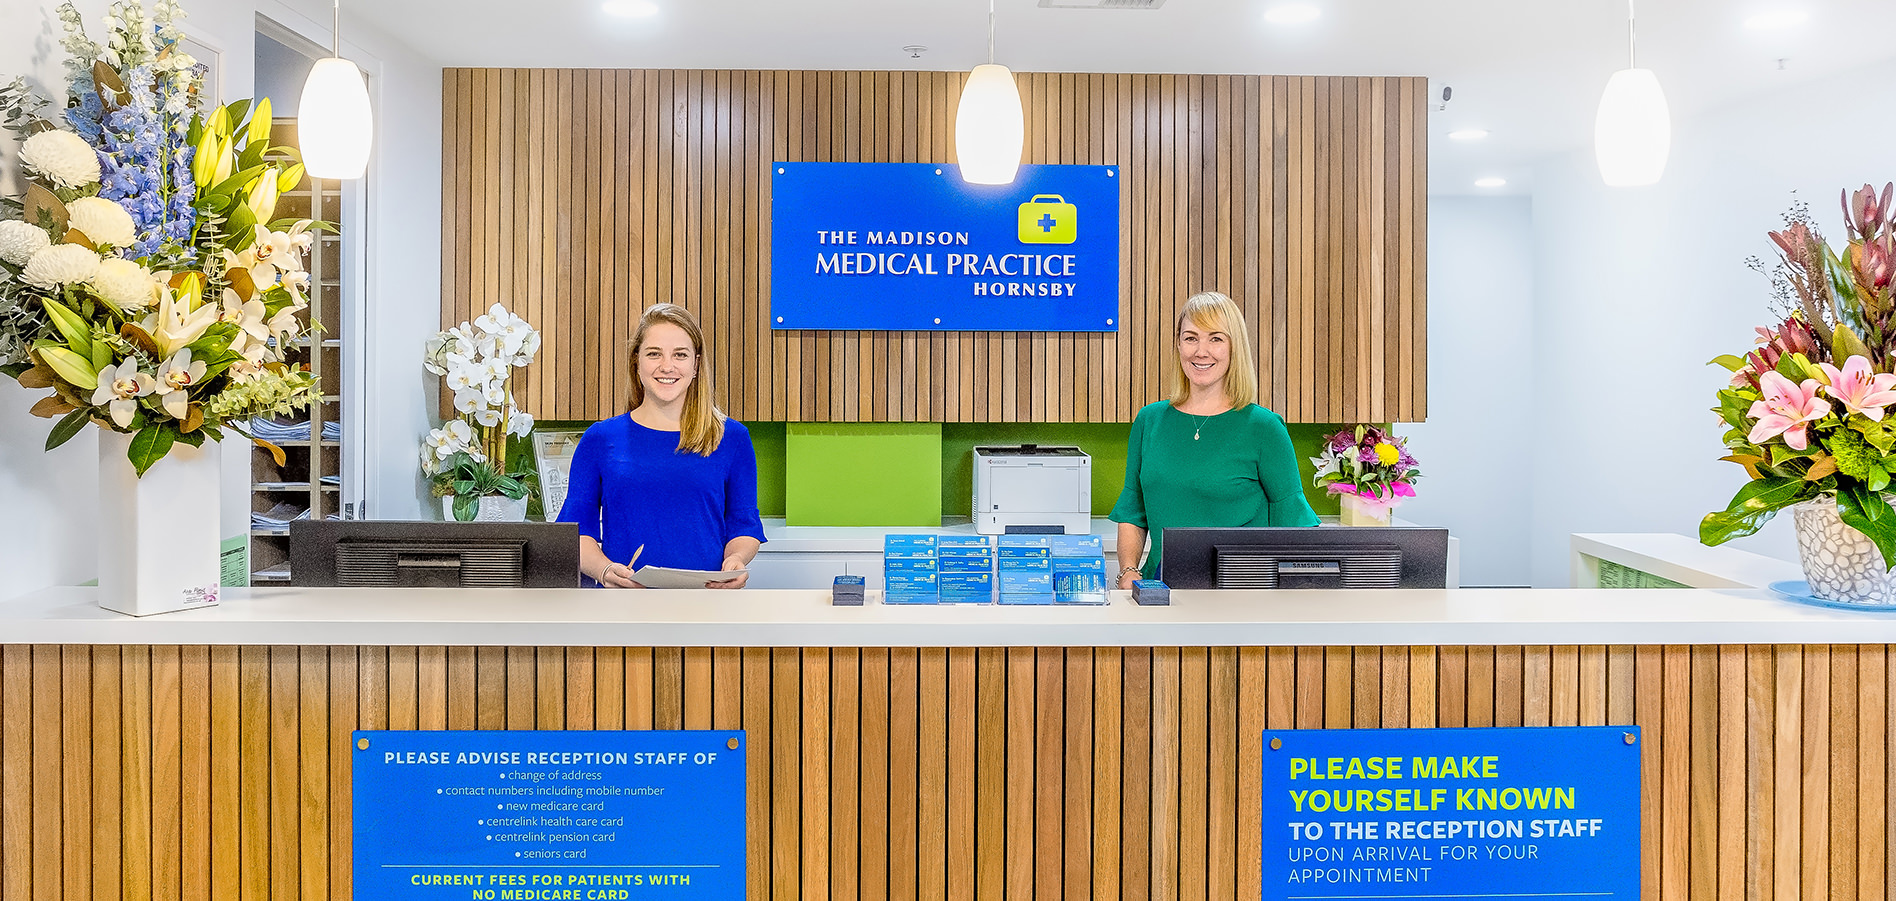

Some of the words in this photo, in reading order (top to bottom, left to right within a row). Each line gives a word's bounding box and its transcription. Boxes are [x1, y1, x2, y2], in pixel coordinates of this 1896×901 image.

[816, 230, 857, 245] THE
[866, 231, 969, 246] MADISON
[815, 252, 939, 275] MEDICAL
[947, 253, 1076, 277] PRACTICE
[973, 282, 1077, 297] HORNSBY
[1292, 561, 1325, 569] SAMSUNG
[384, 751, 450, 765] PLEASE
[456, 752, 521, 765] ADVISE
[527, 752, 628, 765] RECEPTION
[633, 752, 688, 765] STAFF
[693, 752, 717, 765] OF
[1290, 756, 1403, 780] PLEASE
[1411, 755, 1499, 779] MAKE
[509, 770, 545, 783] change
[548, 769, 560, 781] of
[562, 770, 602, 781] address
[445, 787, 485, 796] contact
[488, 786, 534, 796] numbers
[536, 785, 584, 798] including
[586, 786, 622, 796] mobile
[624, 786, 665, 796] number
[506, 803, 529, 812] new
[531, 801, 579, 811] medicare
[581, 801, 604, 811] card
[1288, 788, 1448, 813] YOURSELF
[1456, 786, 1575, 811] KNOWN
[486, 817, 538, 827] centrelink
[541, 817, 573, 827] health
[575, 818, 599, 828] care
[601, 817, 624, 827] card
[1288, 821, 1324, 841] TO
[1329, 821, 1379, 840] THE
[1385, 819, 1523, 840] RECEPTION
[1529, 818, 1603, 839] STAFF
[494, 832, 546, 842] centrelink
[549, 833, 590, 844] pension
[592, 832, 615, 842] card
[523, 849, 561, 859] seniors
[563, 849, 587, 859] card
[1288, 846, 1344, 863] UPON
[1352, 846, 1433, 862] ARRIVAL
[1440, 845, 1478, 861] FOR
[1485, 844, 1538, 860] YOUR
[410, 874, 485, 886] CURRENT
[489, 874, 527, 886] FEES
[532, 874, 563, 886] FOR
[568, 874, 643, 886] PATIENTS
[648, 874, 690, 886] WITH
[1287, 867, 1432, 884] APPOINTMENT
[472, 889, 496, 901] NO
[501, 889, 582, 901] MEDICARE
[586, 889, 629, 901] CARD
